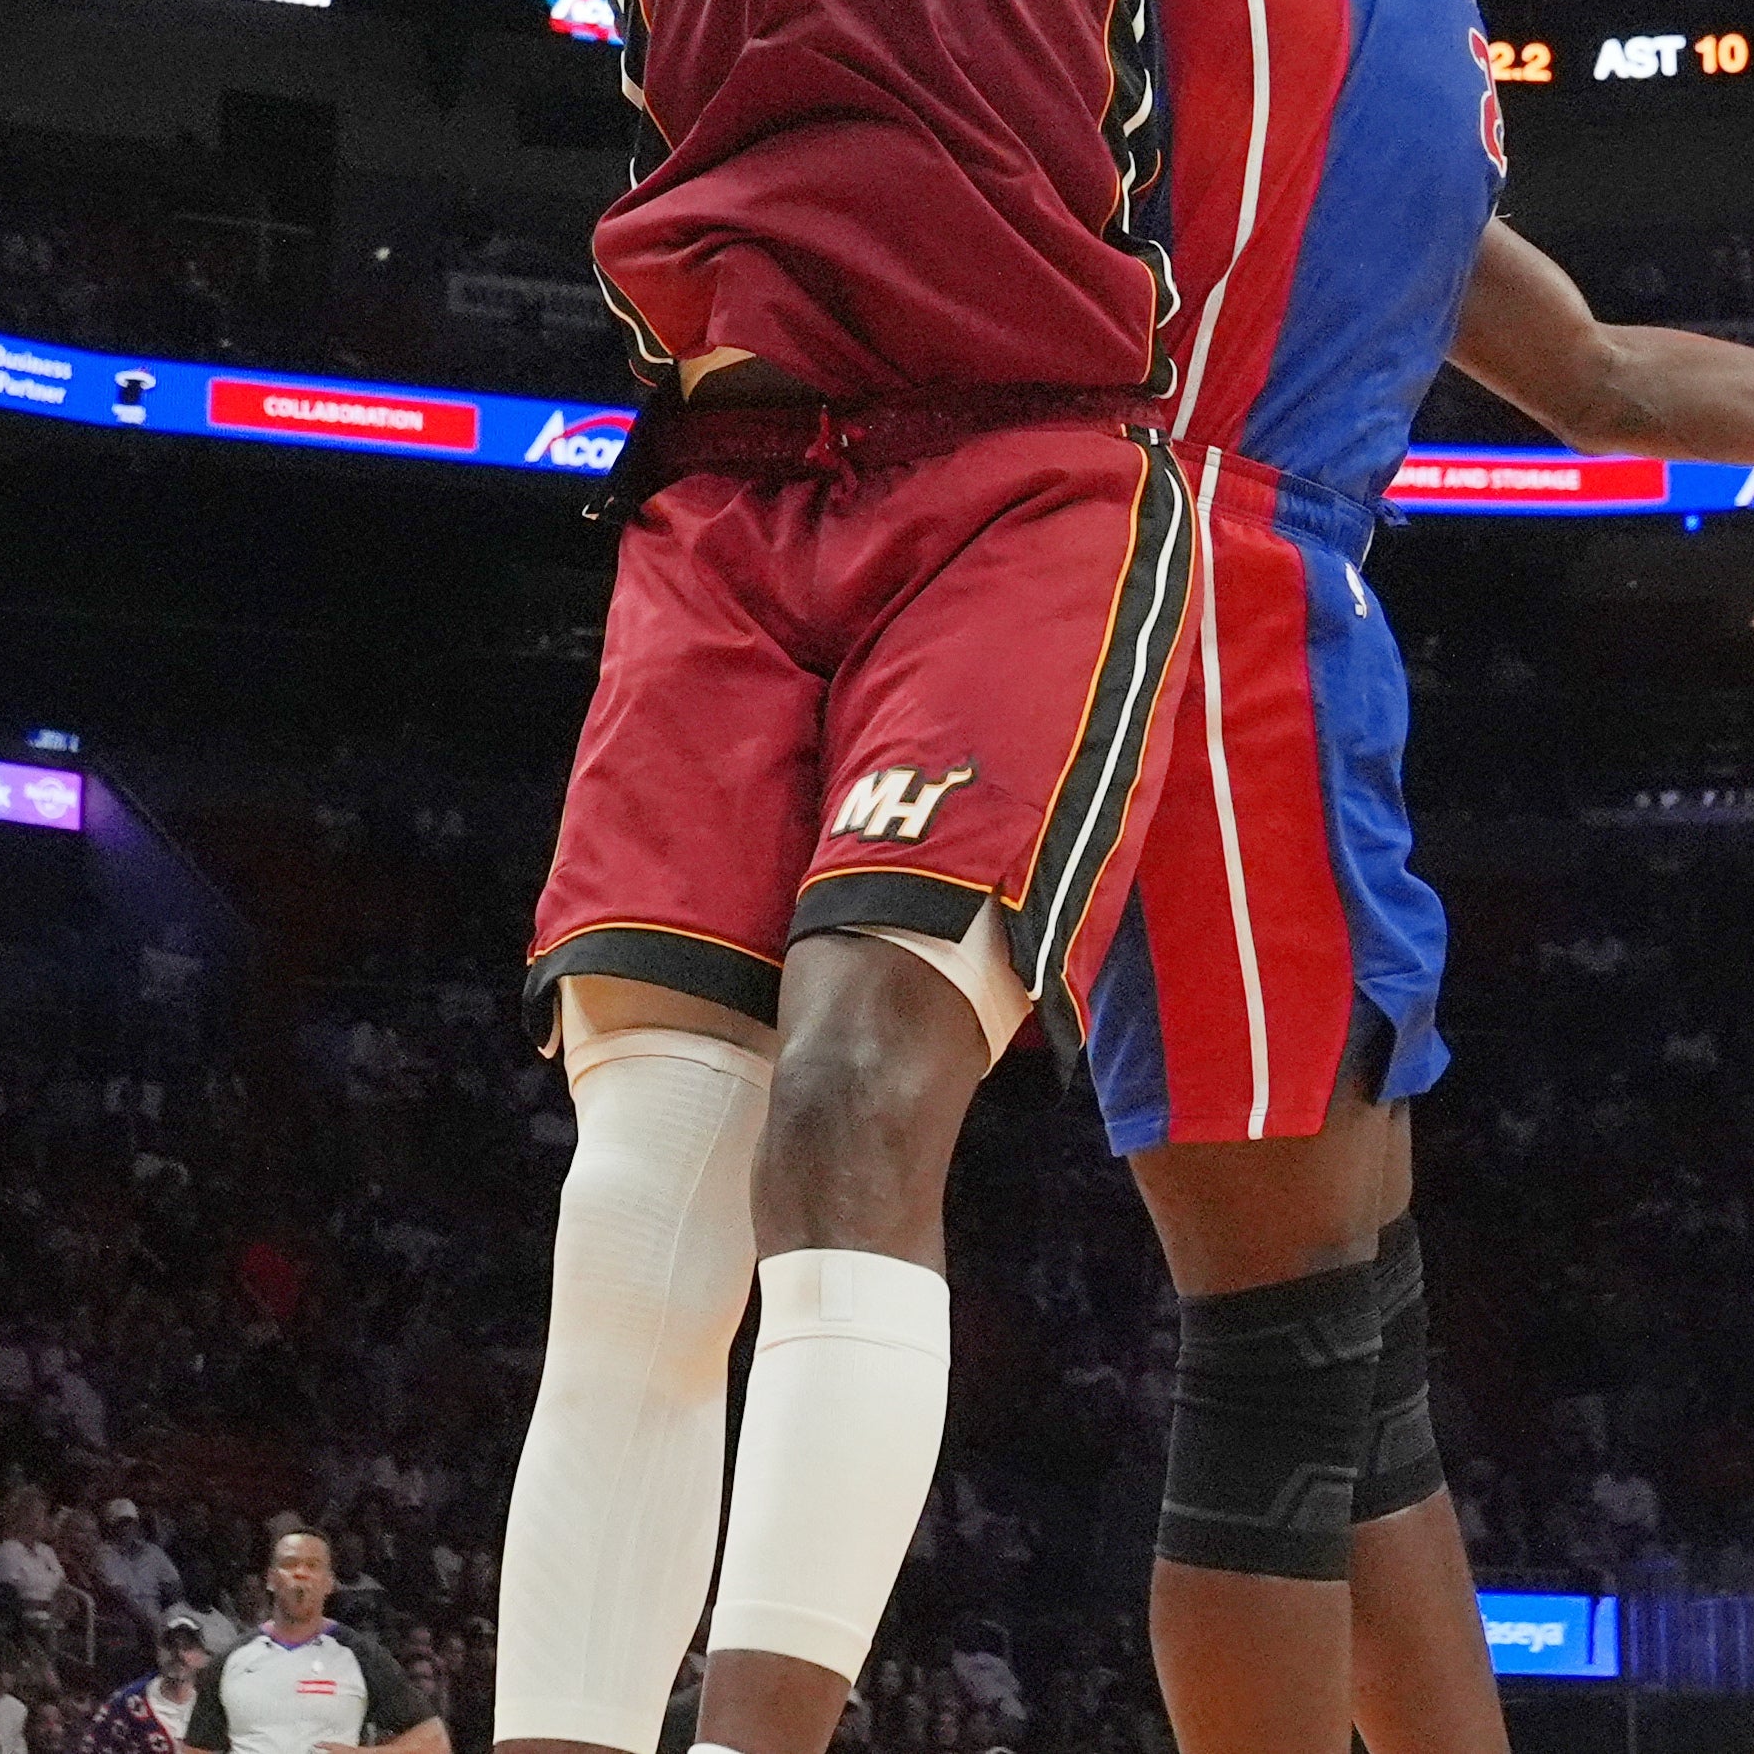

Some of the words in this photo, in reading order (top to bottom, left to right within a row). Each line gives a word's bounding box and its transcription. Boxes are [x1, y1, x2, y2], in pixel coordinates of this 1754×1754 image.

[1594, 34, 1687, 82] AST
[1694, 32, 1750, 75] 10
[262, 394, 424, 432] COLLABORATION
